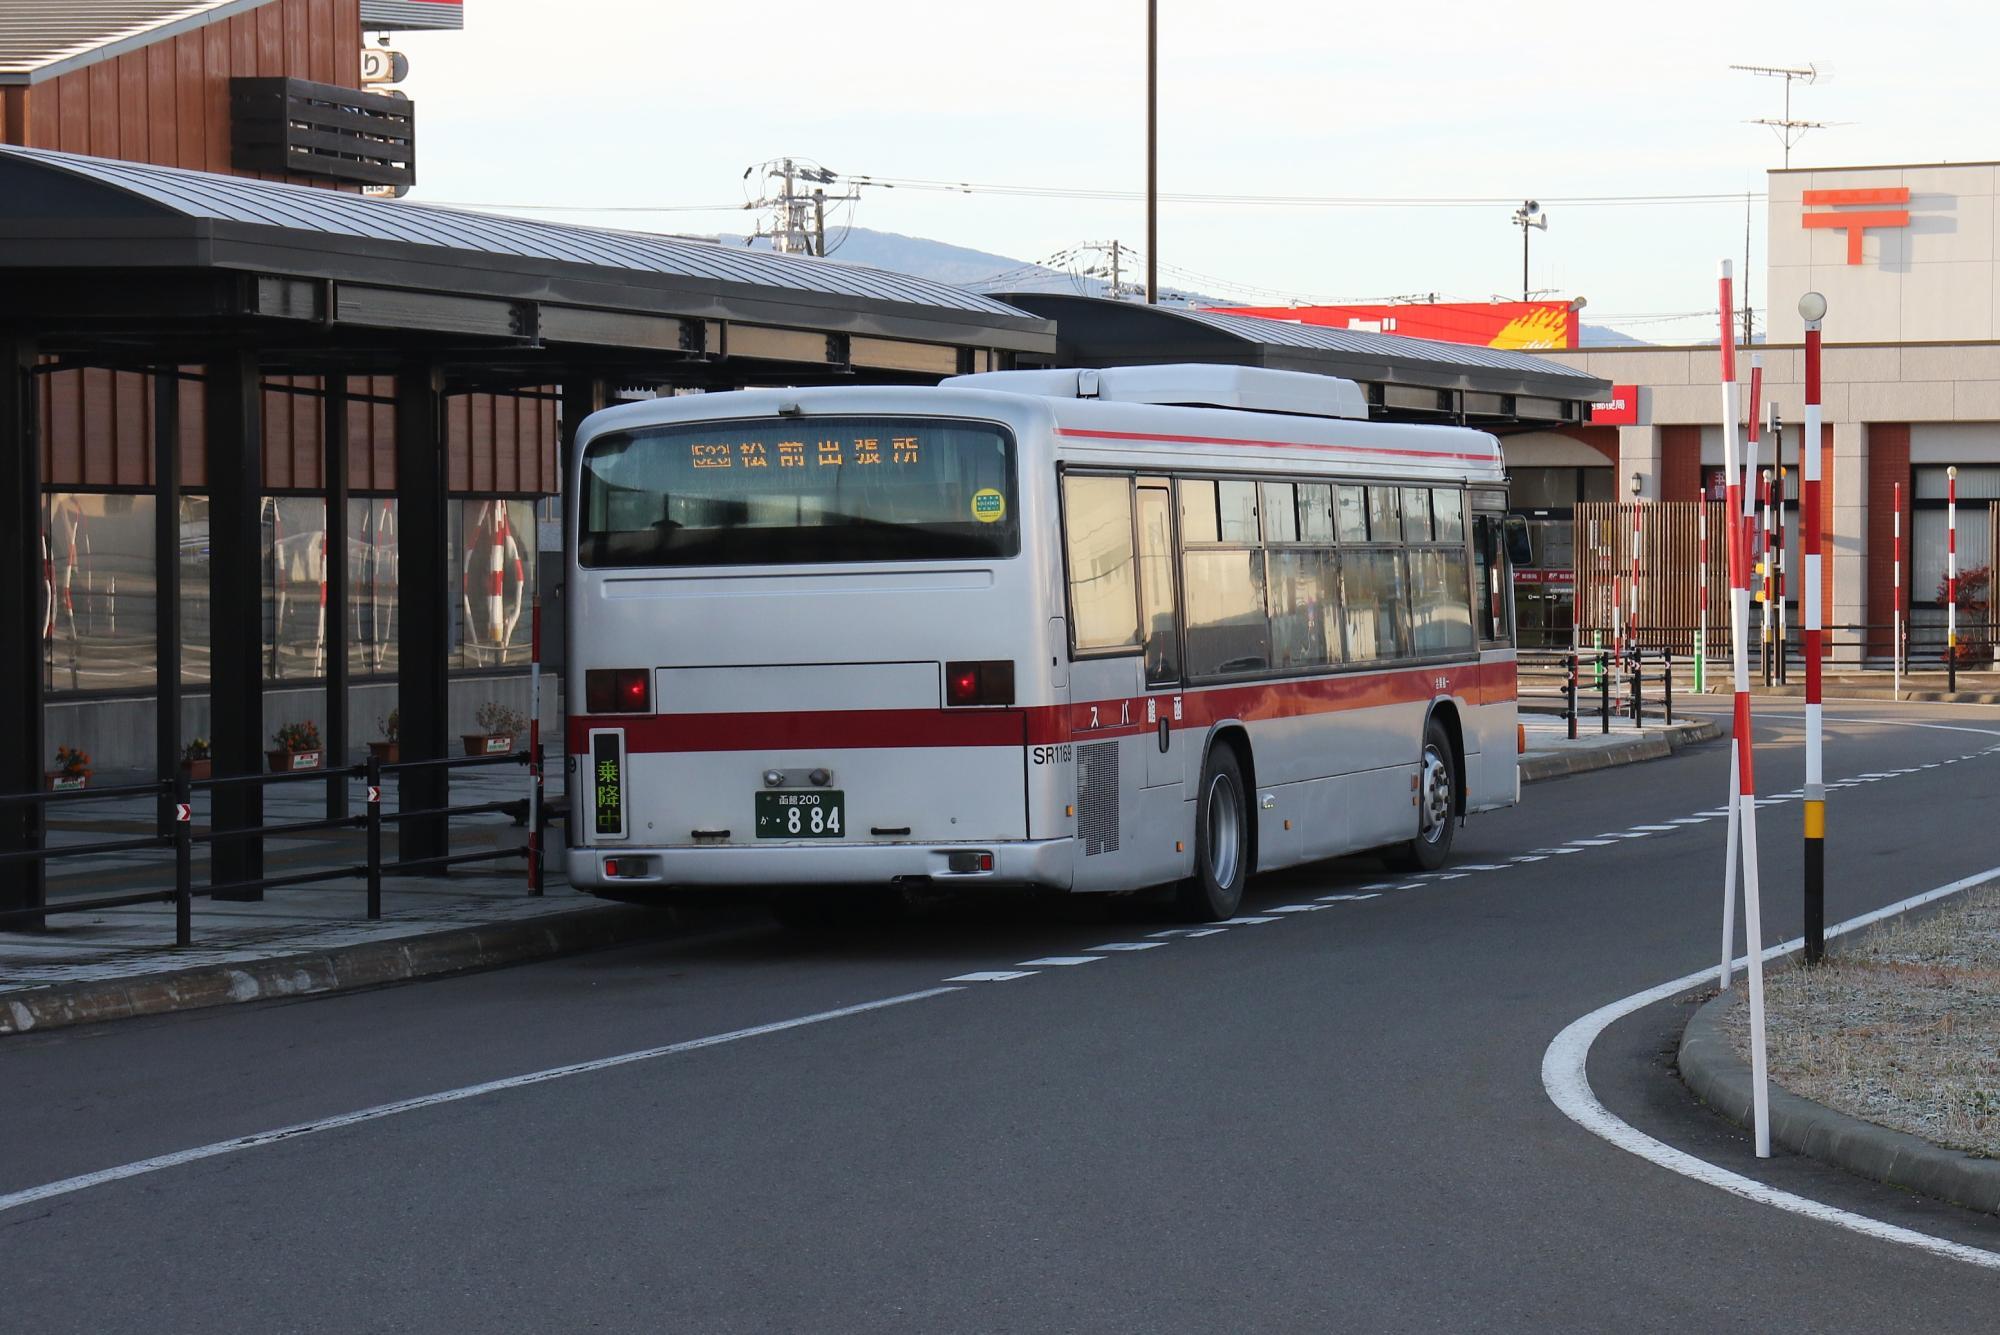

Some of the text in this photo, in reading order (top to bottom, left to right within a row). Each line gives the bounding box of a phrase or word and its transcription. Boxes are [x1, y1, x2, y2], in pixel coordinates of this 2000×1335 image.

[1033, 744, 1072, 765] SR1169
[597, 759, 620, 832] 乗降中
[799, 794, 820, 805] 200
